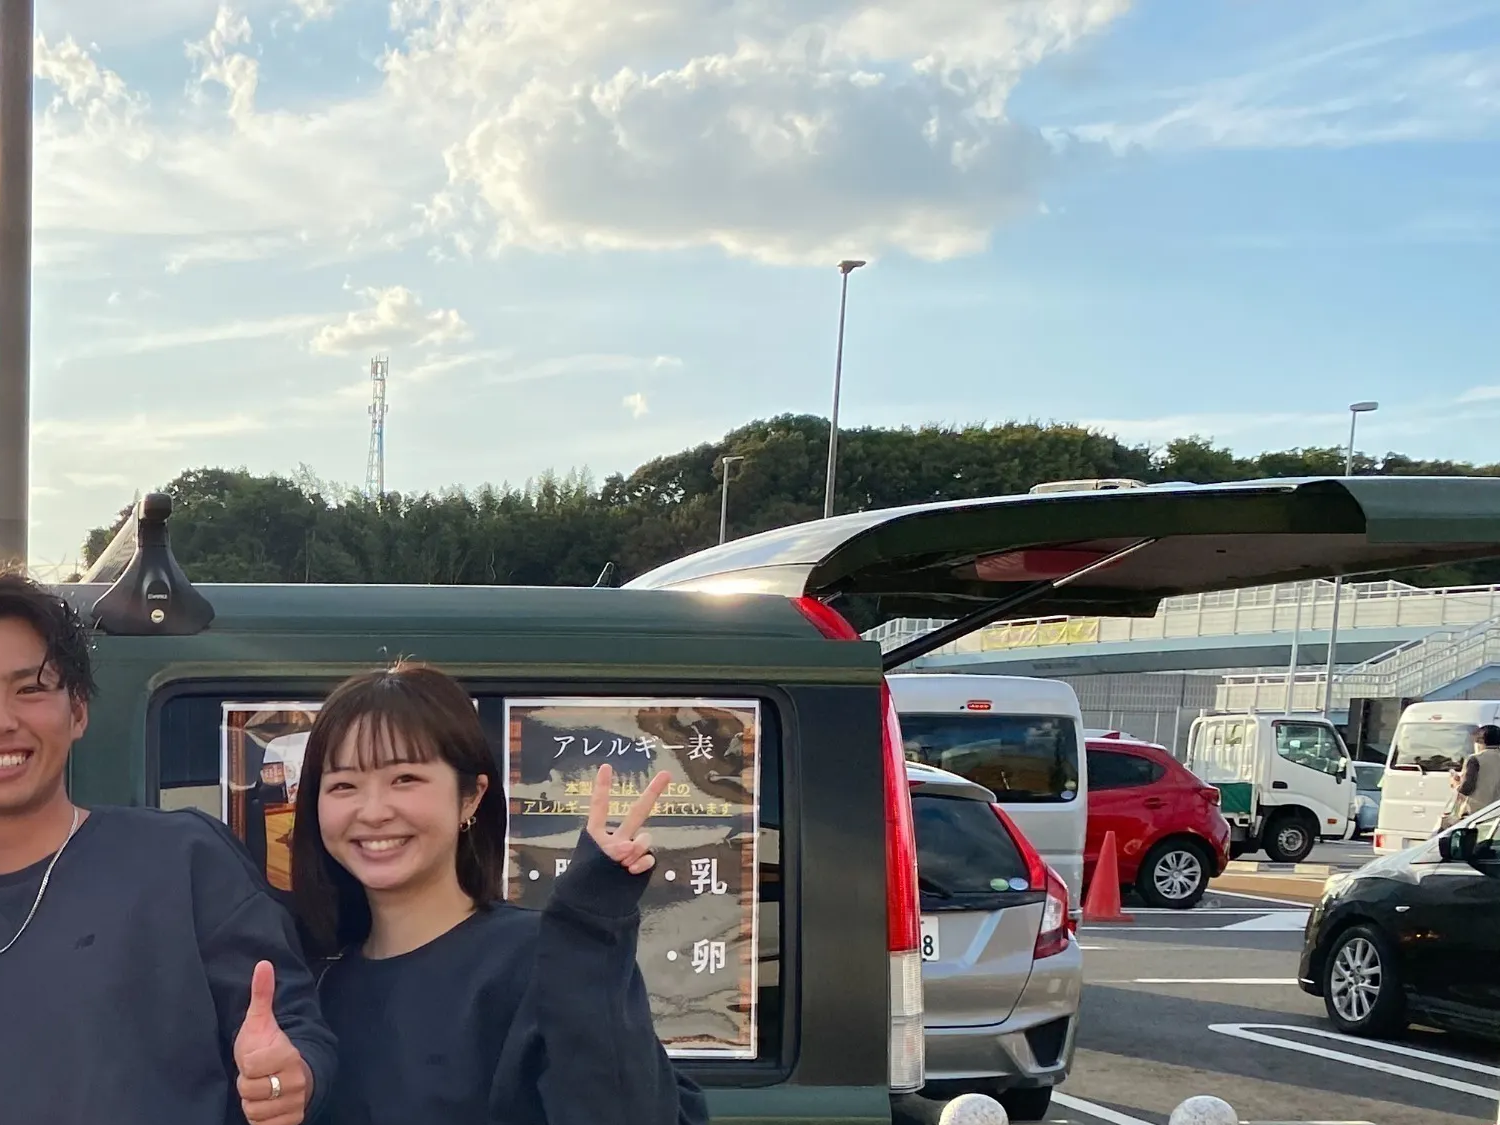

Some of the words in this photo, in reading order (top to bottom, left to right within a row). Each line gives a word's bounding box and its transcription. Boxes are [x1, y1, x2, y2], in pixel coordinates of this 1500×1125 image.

[553, 734, 714, 760] アレルギー表
